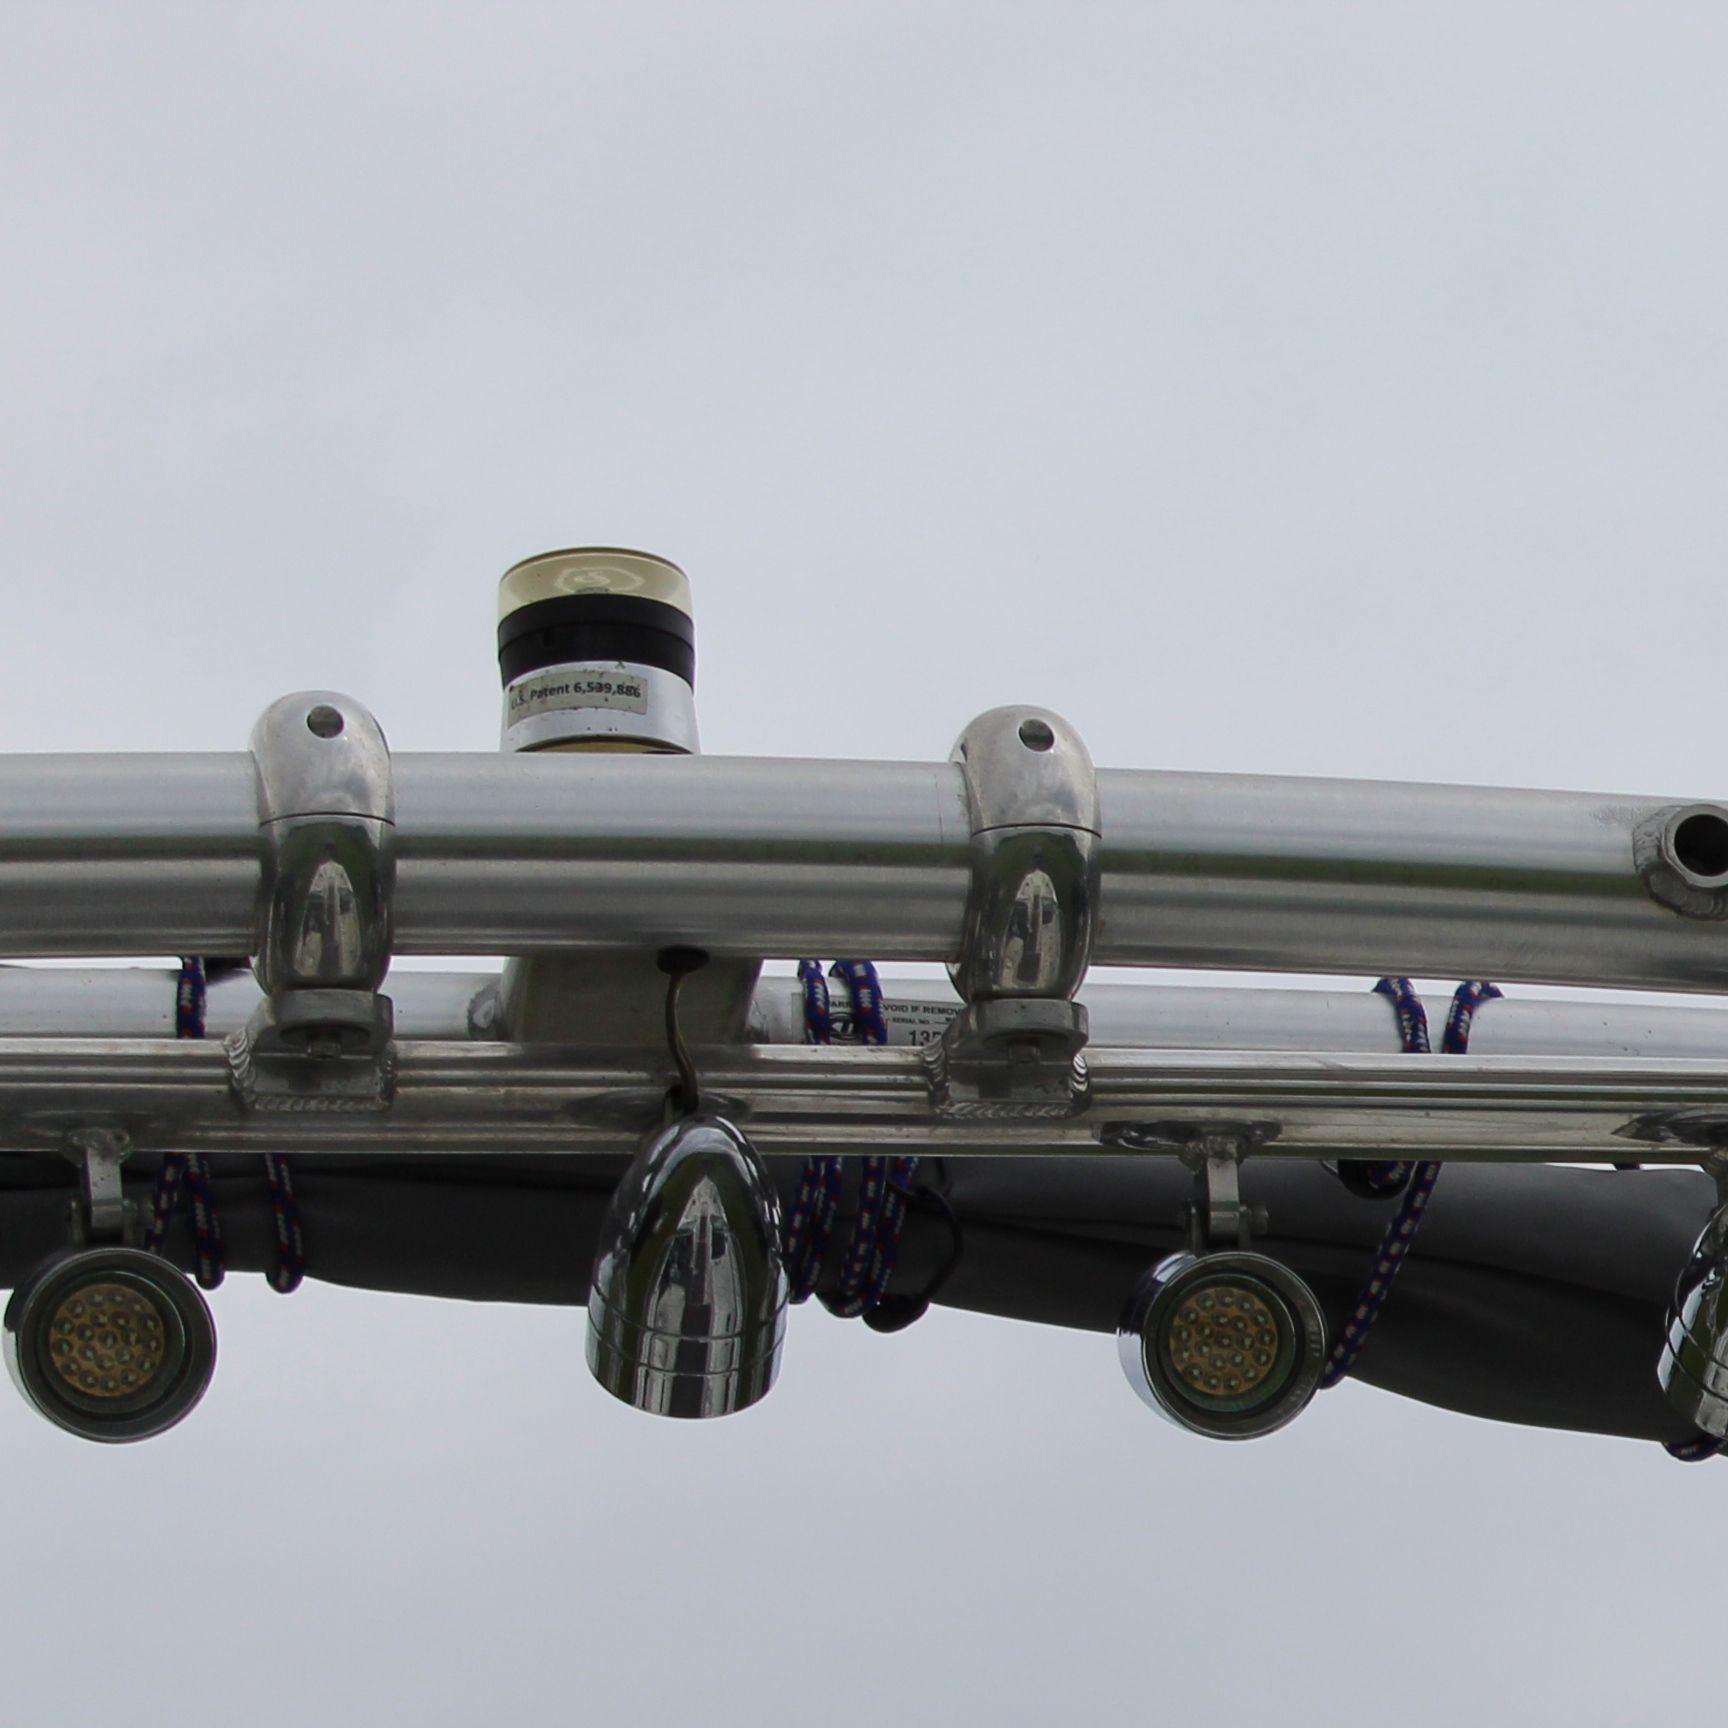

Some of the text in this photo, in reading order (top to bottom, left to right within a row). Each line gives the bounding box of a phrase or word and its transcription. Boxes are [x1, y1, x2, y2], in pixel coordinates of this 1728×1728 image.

[530, 684, 570, 700] Patent
[884, 1004, 961, 1016] VOID IF REMOV
